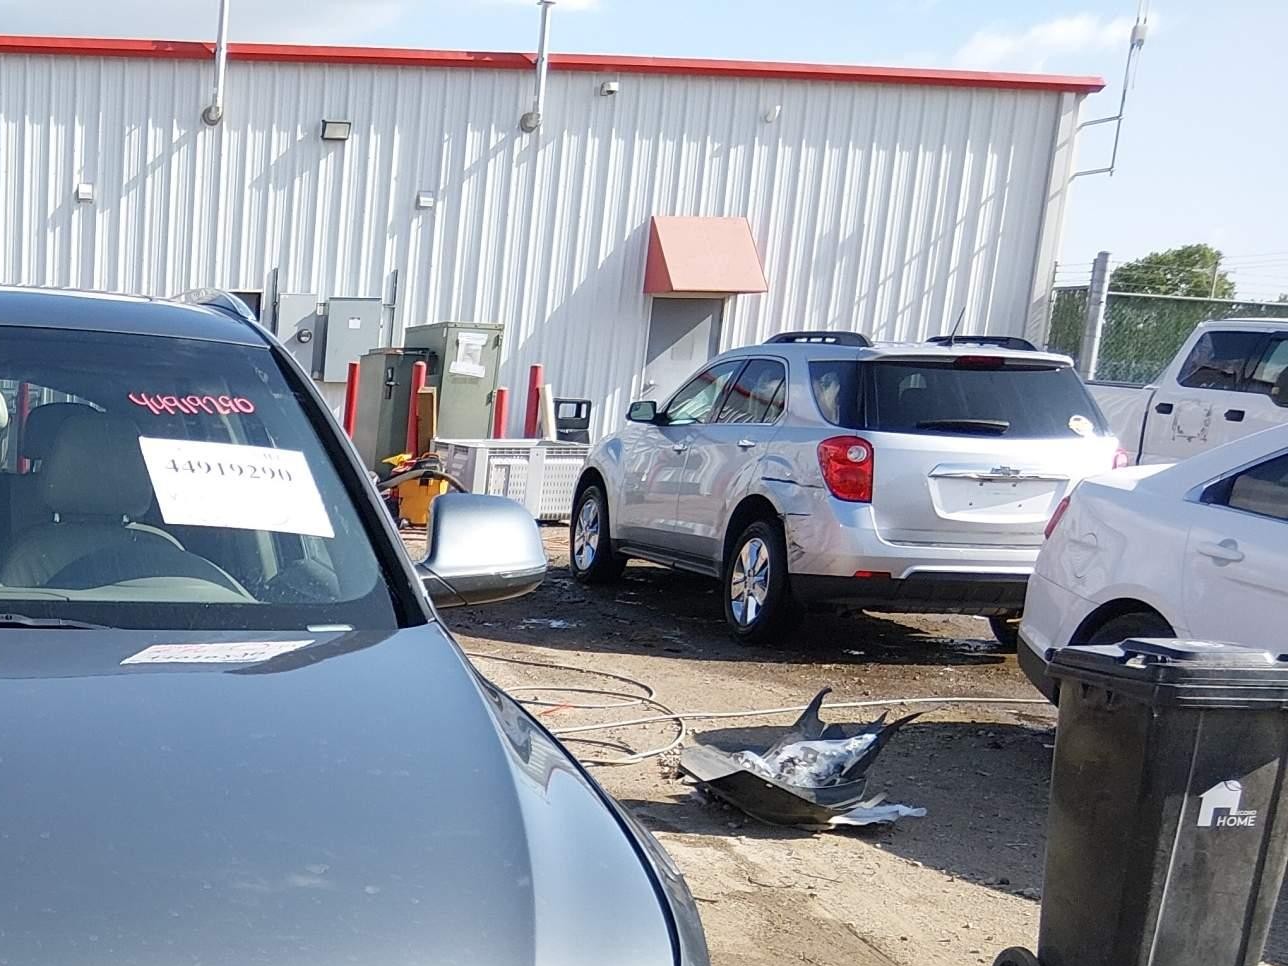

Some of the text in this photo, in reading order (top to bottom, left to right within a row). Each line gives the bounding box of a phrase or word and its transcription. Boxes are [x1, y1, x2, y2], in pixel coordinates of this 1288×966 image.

[128, 392, 255, 415] 44919290
[166, 458, 293, 482] 44919290
[1216, 816, 1256, 827] HOME
